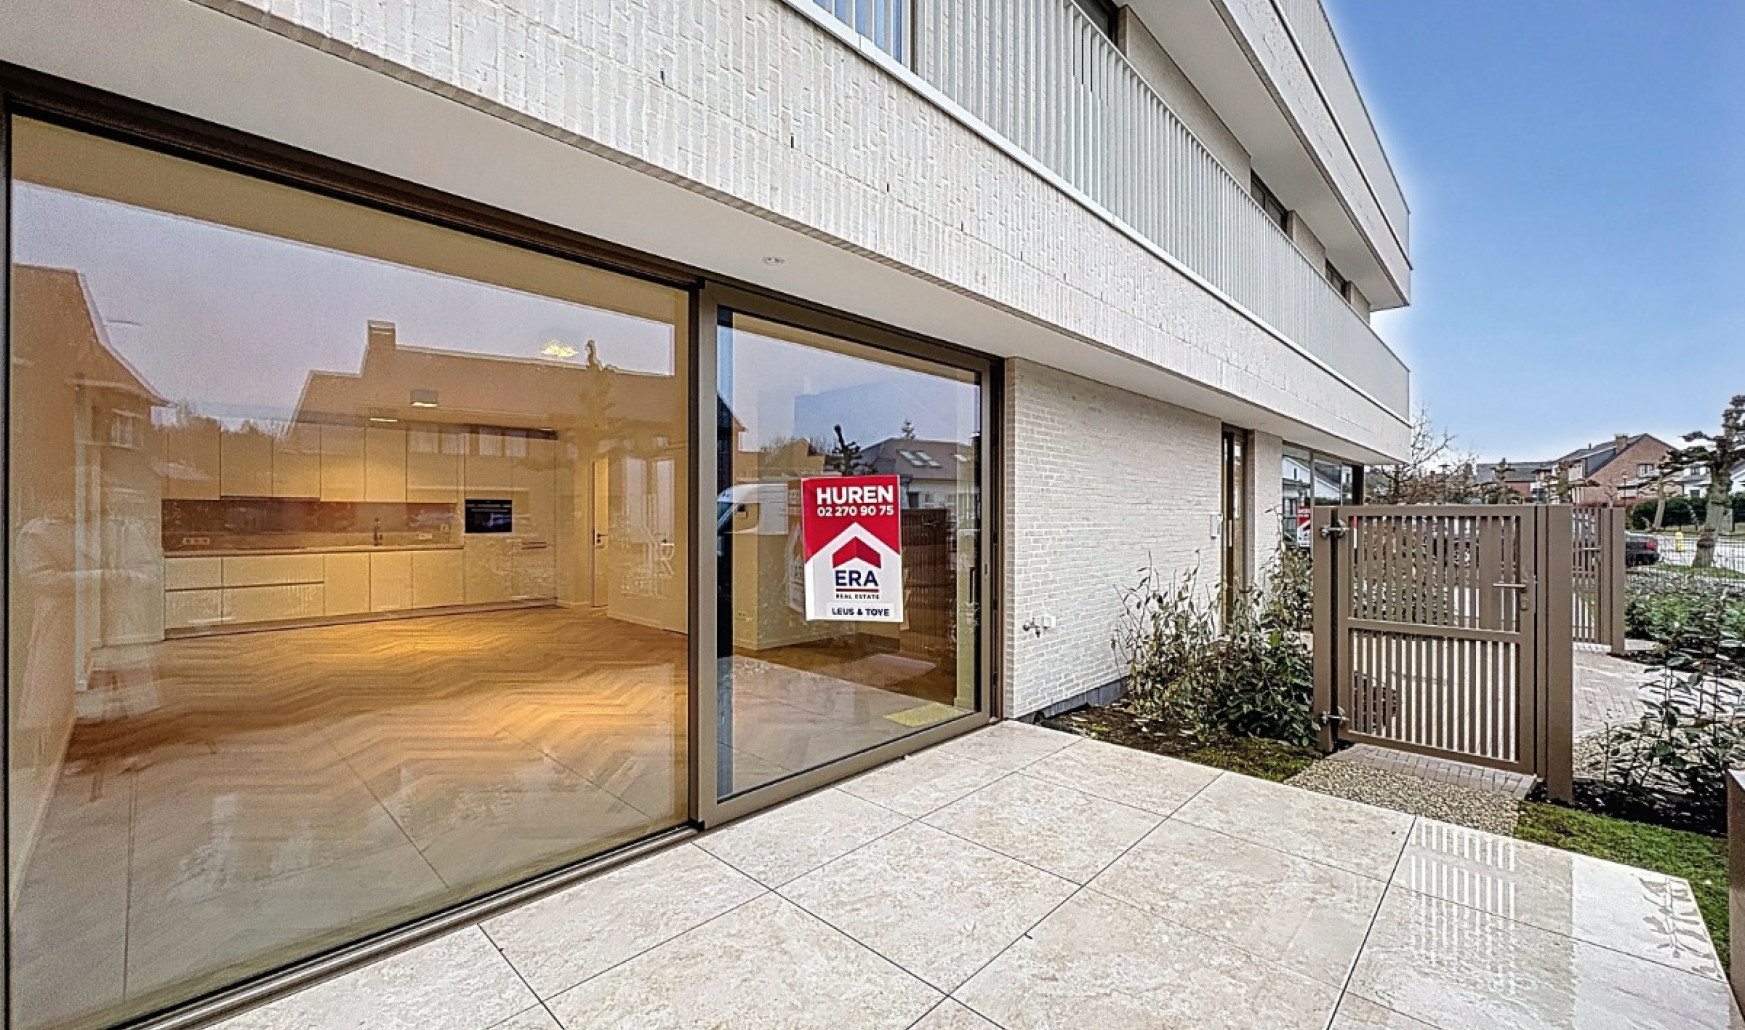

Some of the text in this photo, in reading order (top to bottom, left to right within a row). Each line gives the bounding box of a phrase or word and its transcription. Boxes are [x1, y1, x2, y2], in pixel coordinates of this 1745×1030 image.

[816, 485, 894, 505] HUREN
[817, 505, 894, 517] 02 270 90 75
[835, 570, 879, 587] ERA
[832, 607, 890, 617] LEUS & TOYE
